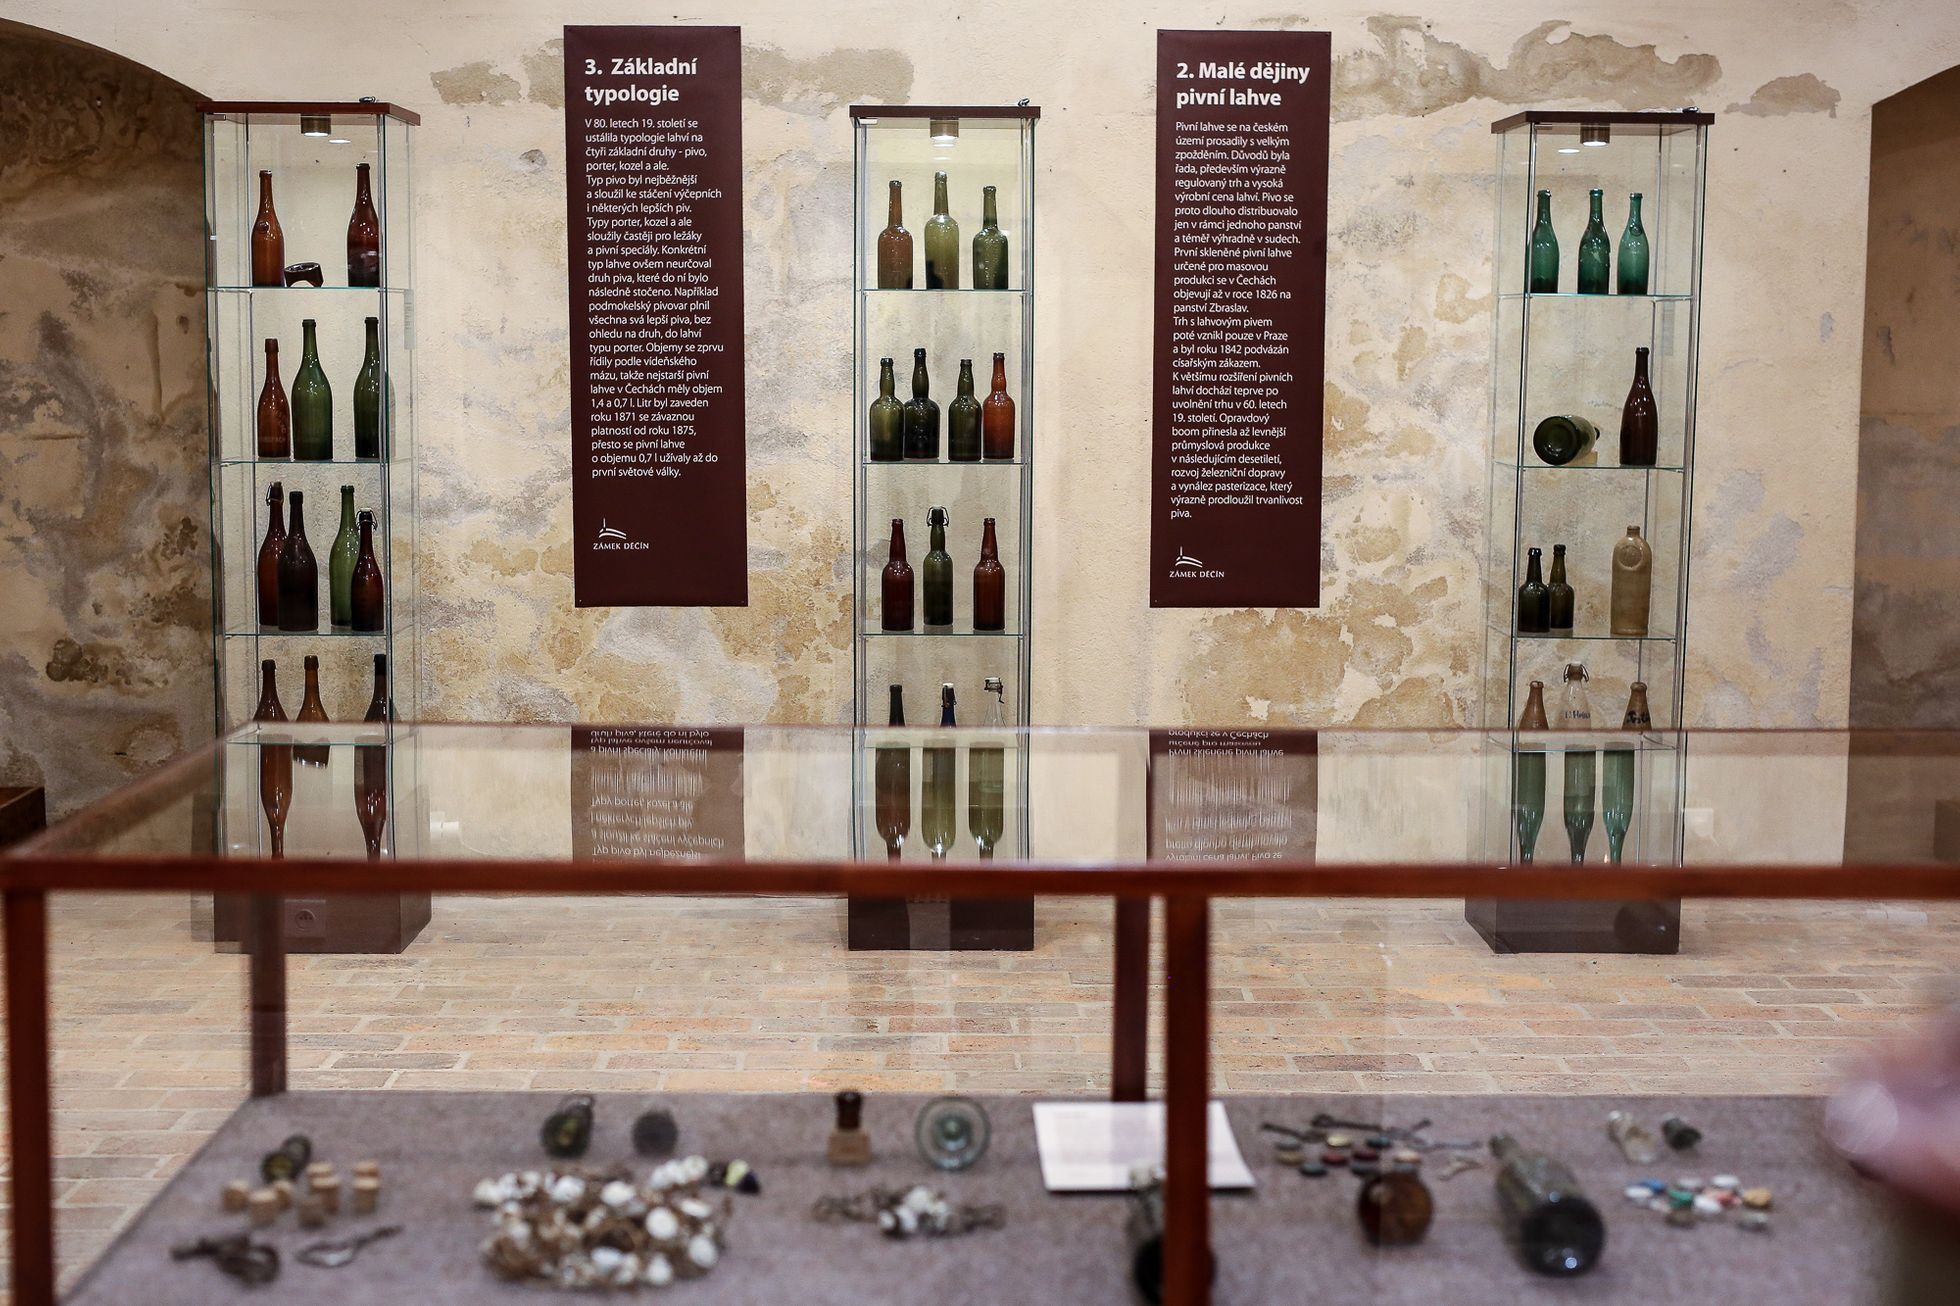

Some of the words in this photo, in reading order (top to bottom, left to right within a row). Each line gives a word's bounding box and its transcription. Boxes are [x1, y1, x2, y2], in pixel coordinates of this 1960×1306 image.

[585, 57, 603, 75] 3.
[611, 57, 698, 75] Základní
[1176, 61, 1195, 79] 2.
[1198, 61, 1246, 79] Malé
[1250, 61, 1310, 83] dějiny
[584, 84, 680, 106] typologie
[1176, 88, 1226, 110] pivní
[1230, 88, 1282, 106] lahve
[1176, 121, 1199, 132] Pivní
[1200, 121, 1225, 132] lahve
[1226, 123, 1238, 132] se
[1239, 123, 1251, 132] na
[1252, 121, 1288, 132] českém
[585, 132, 618, 142] ustálila
[620, 132, 666, 146] typologie
[667, 132, 690, 142] lahví
[691, 134, 703, 142] na
[1175, 135, 1205, 146] území
[1206, 135, 1248, 149] prosadily
[1249, 138, 1255, 146] s
[1256, 135, 1290, 149] velkým
[1175, 149, 1230, 163] zpožděním.
[1231, 149, 1269, 160] Důvodů
[1270, 149, 1290, 163] byla
[586, 159, 618, 174] porter,
[619, 159, 643, 170] kozel
[645, 162, 651, 170] a
[653, 159, 670, 170] ale.
[1175, 163, 1198, 176] řada,
[1199, 163, 1248, 177] především
[1250, 163, 1286, 177] výrazně
[586, 174, 604, 188] Typ
[605, 174, 626, 188] pivo
[628, 174, 643, 188] byl
[644, 174, 698, 188] nejběžnější
[1175, 177, 1227, 191] regulovaný
[1228, 177, 1242, 188] trh
[1244, 179, 1250, 188] a
[1251, 177, 1284, 191] vysoká
[586, 202, 590, 213] i
[592, 202, 638, 216] některých
[640, 202, 674, 216] lepších
[675, 202, 692, 216] piv.
[587, 230, 622, 244] sloužily
[623, 230, 653, 244] častěji
[655, 232, 672, 244] pro
[673, 230, 703, 244] ležáky
[1174, 246, 1198, 257] První
[1199, 246, 1241, 257] skleněné
[1242, 246, 1266, 260] pivní
[1267, 246, 1293, 257] lahve
[588, 258, 604, 272] typ
[605, 258, 631, 268] lahve
[632, 258, 664, 268] ovšem
[666, 258, 712, 268] neurčoval
[1174, 260, 1207, 271] určené
[1208, 263, 1225, 274] pro
[1226, 263, 1269, 271] masovou
[1174, 274, 1215, 288] produkci
[1216, 277, 1227, 285] se
[1228, 277, 1235, 285] v
[1236, 273, 1276, 285] Čechách
[588, 286, 631, 296] následně
[633, 286, 673, 296] stočeno.
[674, 286, 719, 300] Například
[588, 300, 652, 314] podmokelský
[653, 300, 688, 314] pivovar
[690, 300, 710, 314] plnil
[1173, 302, 1208, 316] panství
[1208, 302, 1249, 313] Zbraslav.
[588, 314, 628, 325] všechna
[629, 314, 645, 325] svá
[646, 314, 669, 328] lepší
[670, 314, 692, 328] piva,
[694, 314, 712, 325] bez
[1172, 316, 1188, 327] Trh
[1190, 318, 1195, 327] s
[1197, 316, 1242, 330] lahvovým
[1243, 316, 1273, 330] pivem
[588, 328, 622, 338] ohledu
[624, 330, 636, 338] na
[638, 328, 663, 340] druh,
[664, 328, 678, 338] do
[680, 328, 702, 338] lahví
[1172, 346, 1178, 354] a
[1180, 343, 1195, 357] byl
[1196, 343, 1218, 354] roku
[1220, 343, 1242, 354] 1842
[1244, 343, 1289, 357] podvázán
[590, 355, 613, 369] řídily
[614, 355, 642, 369] podle
[643, 355, 697, 366] vídeňského
[1172, 357, 1217, 371] císařským
[1218, 357, 1261, 368] zákazem.
[590, 369, 618, 382] mázu,
[620, 369, 644, 380] takže
[646, 369, 685, 383] nejstarší
[686, 369, 710, 383] pivní
[1172, 384, 1194, 395] lahví
[1195, 384, 1232, 395] dochází
[1234, 384, 1264, 398] teprve
[1266, 387, 1279, 398] po
[590, 411, 612, 422] roku
[614, 411, 636, 422] 1871
[638, 413, 650, 422] se
[651, 411, 695, 422] závaznou
[1173, 412, 1186, 423] 19.
[1187, 412, 1218, 423] století.
[1219, 412, 1270, 426] Opravdový
[591, 424, 632, 438] platností
[633, 424, 646, 435] od
[648, 424, 670, 435] roku
[672, 424, 697, 437] 1875,
[1172, 426, 1200, 437] boom
[1202, 426, 1238, 440] přinesla
[1239, 426, 1250, 437] až
[1252, 426, 1287, 440] levnější
[591, 438, 622, 452] přesto
[623, 440, 634, 449] se
[635, 438, 659, 452] pivní
[660, 438, 686, 449] lahve
[1171, 440, 1225, 454] průmyslová
[1226, 440, 1271, 454] produkce
[592, 466, 617, 480] první
[618, 466, 654, 476] světové
[655, 466, 681, 480] války.
[1171, 467, 1199, 481] rozvoj
[1201, 467, 1247, 478] železniční
[1247, 467, 1286, 481] dopravy
[1170, 494, 1206, 508] výrazně
[1208, 494, 1254, 508] prodloužil
[1256, 494, 1303, 505] trvanlivost
[1170, 507, 1192, 522] piva.
[593, 541, 621, 550] ZÁMEK
[1169, 569, 1197, 578] ZÁMEK
